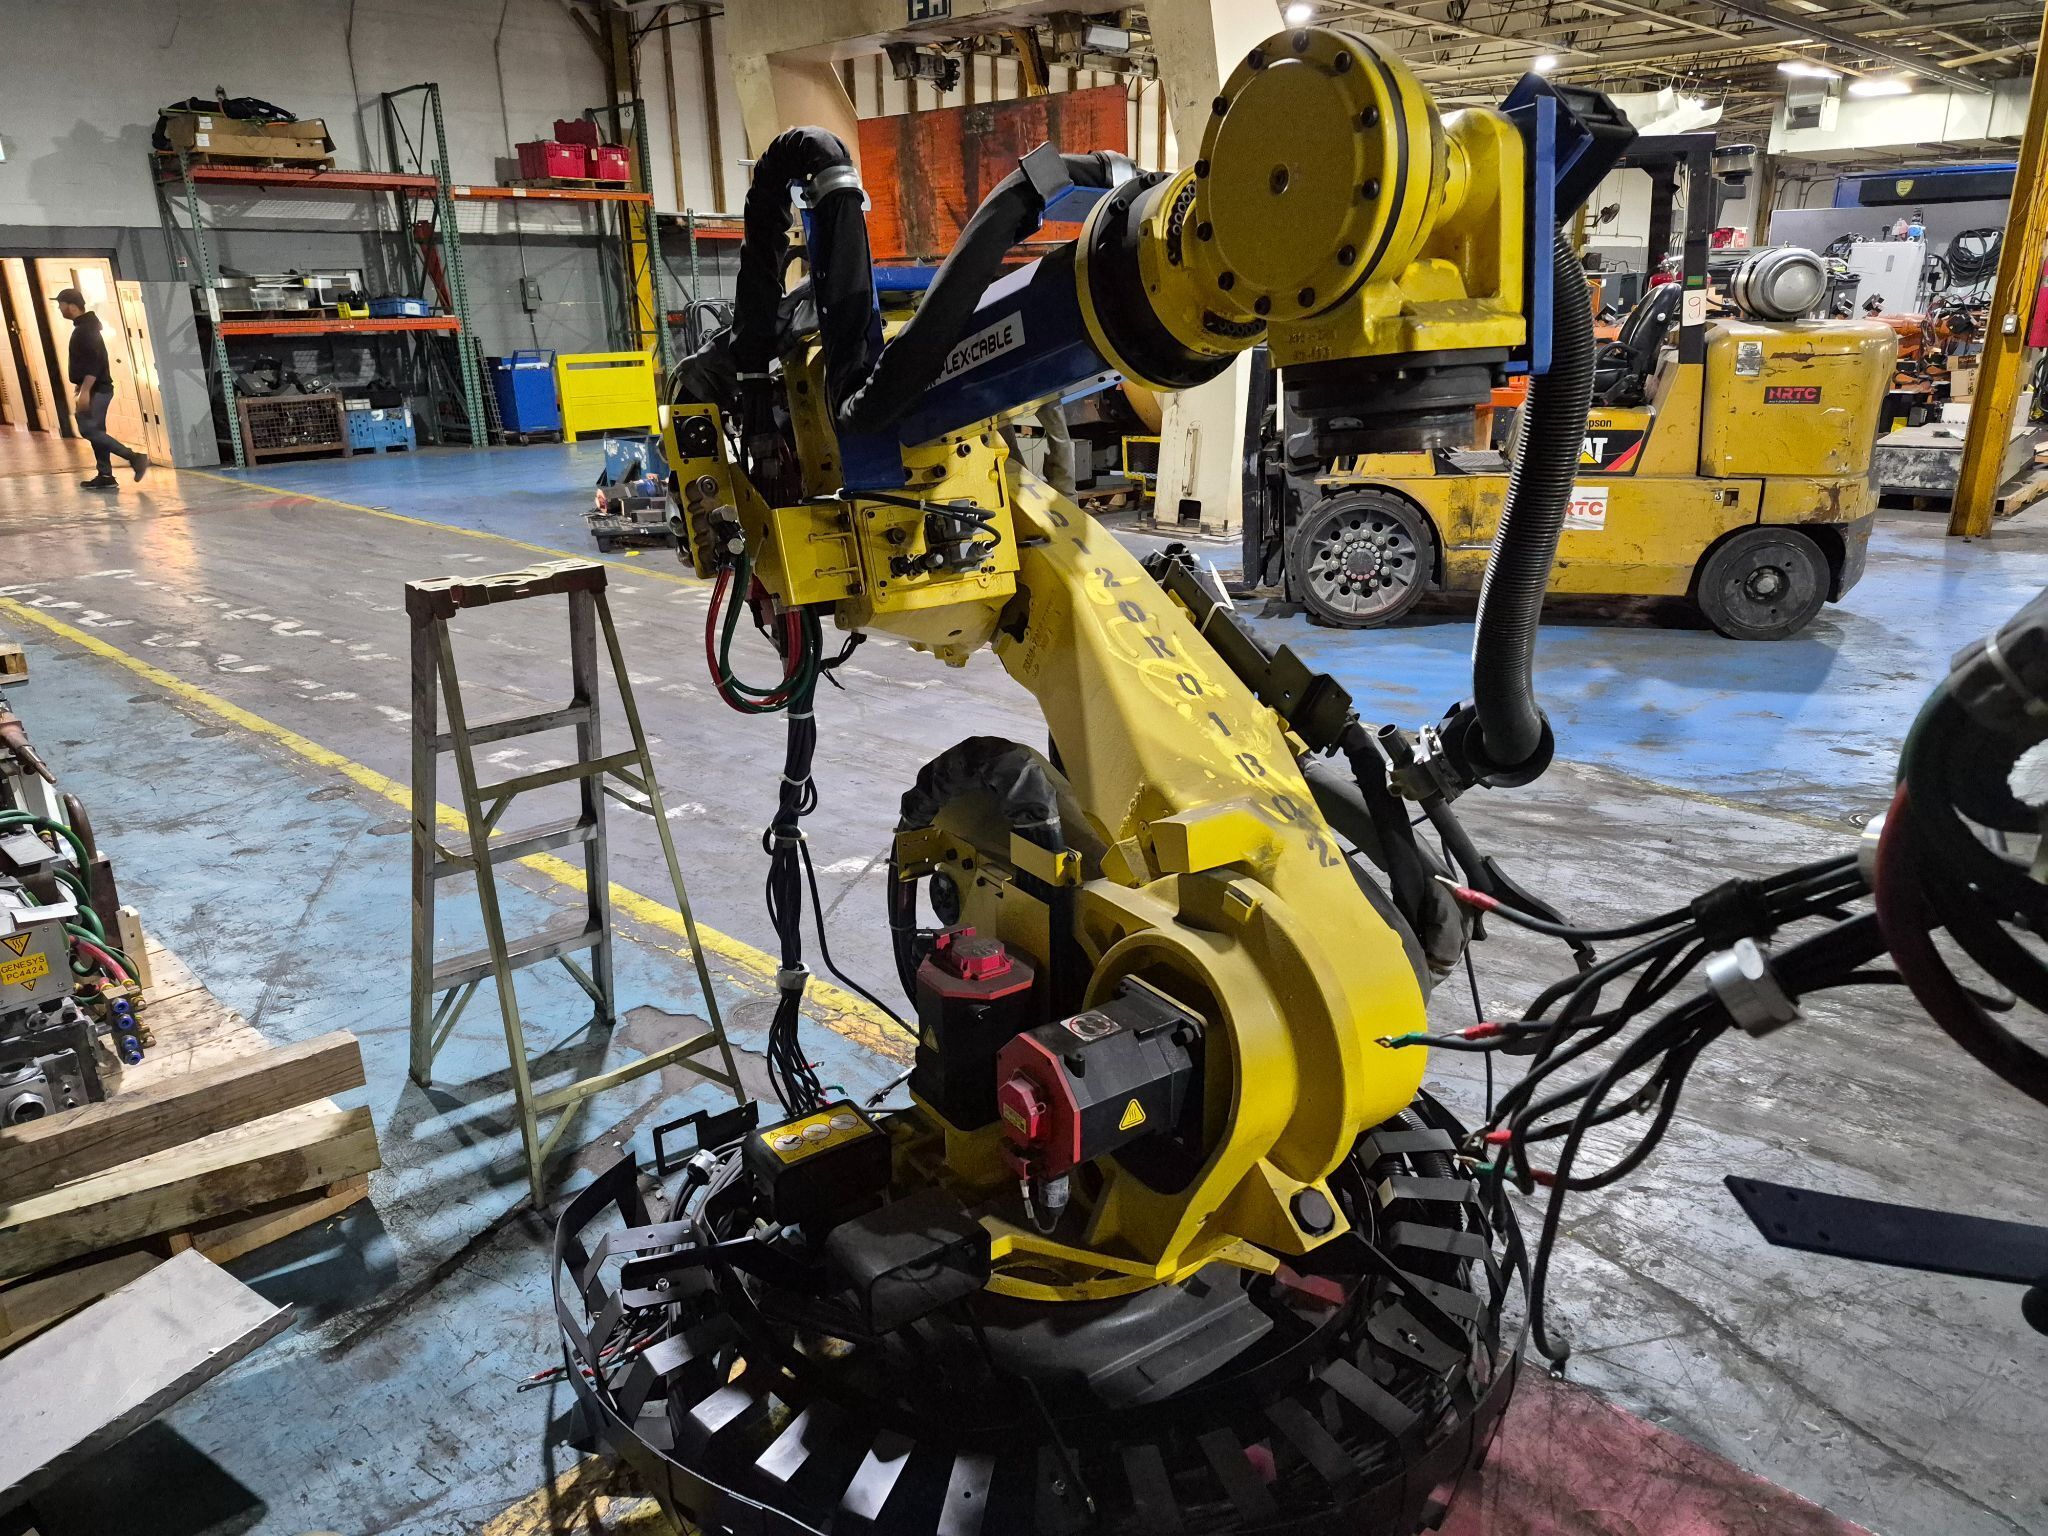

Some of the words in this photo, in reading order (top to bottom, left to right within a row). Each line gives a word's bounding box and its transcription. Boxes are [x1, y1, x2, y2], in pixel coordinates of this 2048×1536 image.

[1768, 387, 1818, 400] NRTC
[1587, 419, 1612, 430] pson
[1580, 437, 1609, 464] AT
[1566, 501, 1604, 516] RTC
[1, 955, 46, 974] GENESYS
[6, 966, 44, 981] PC4424
